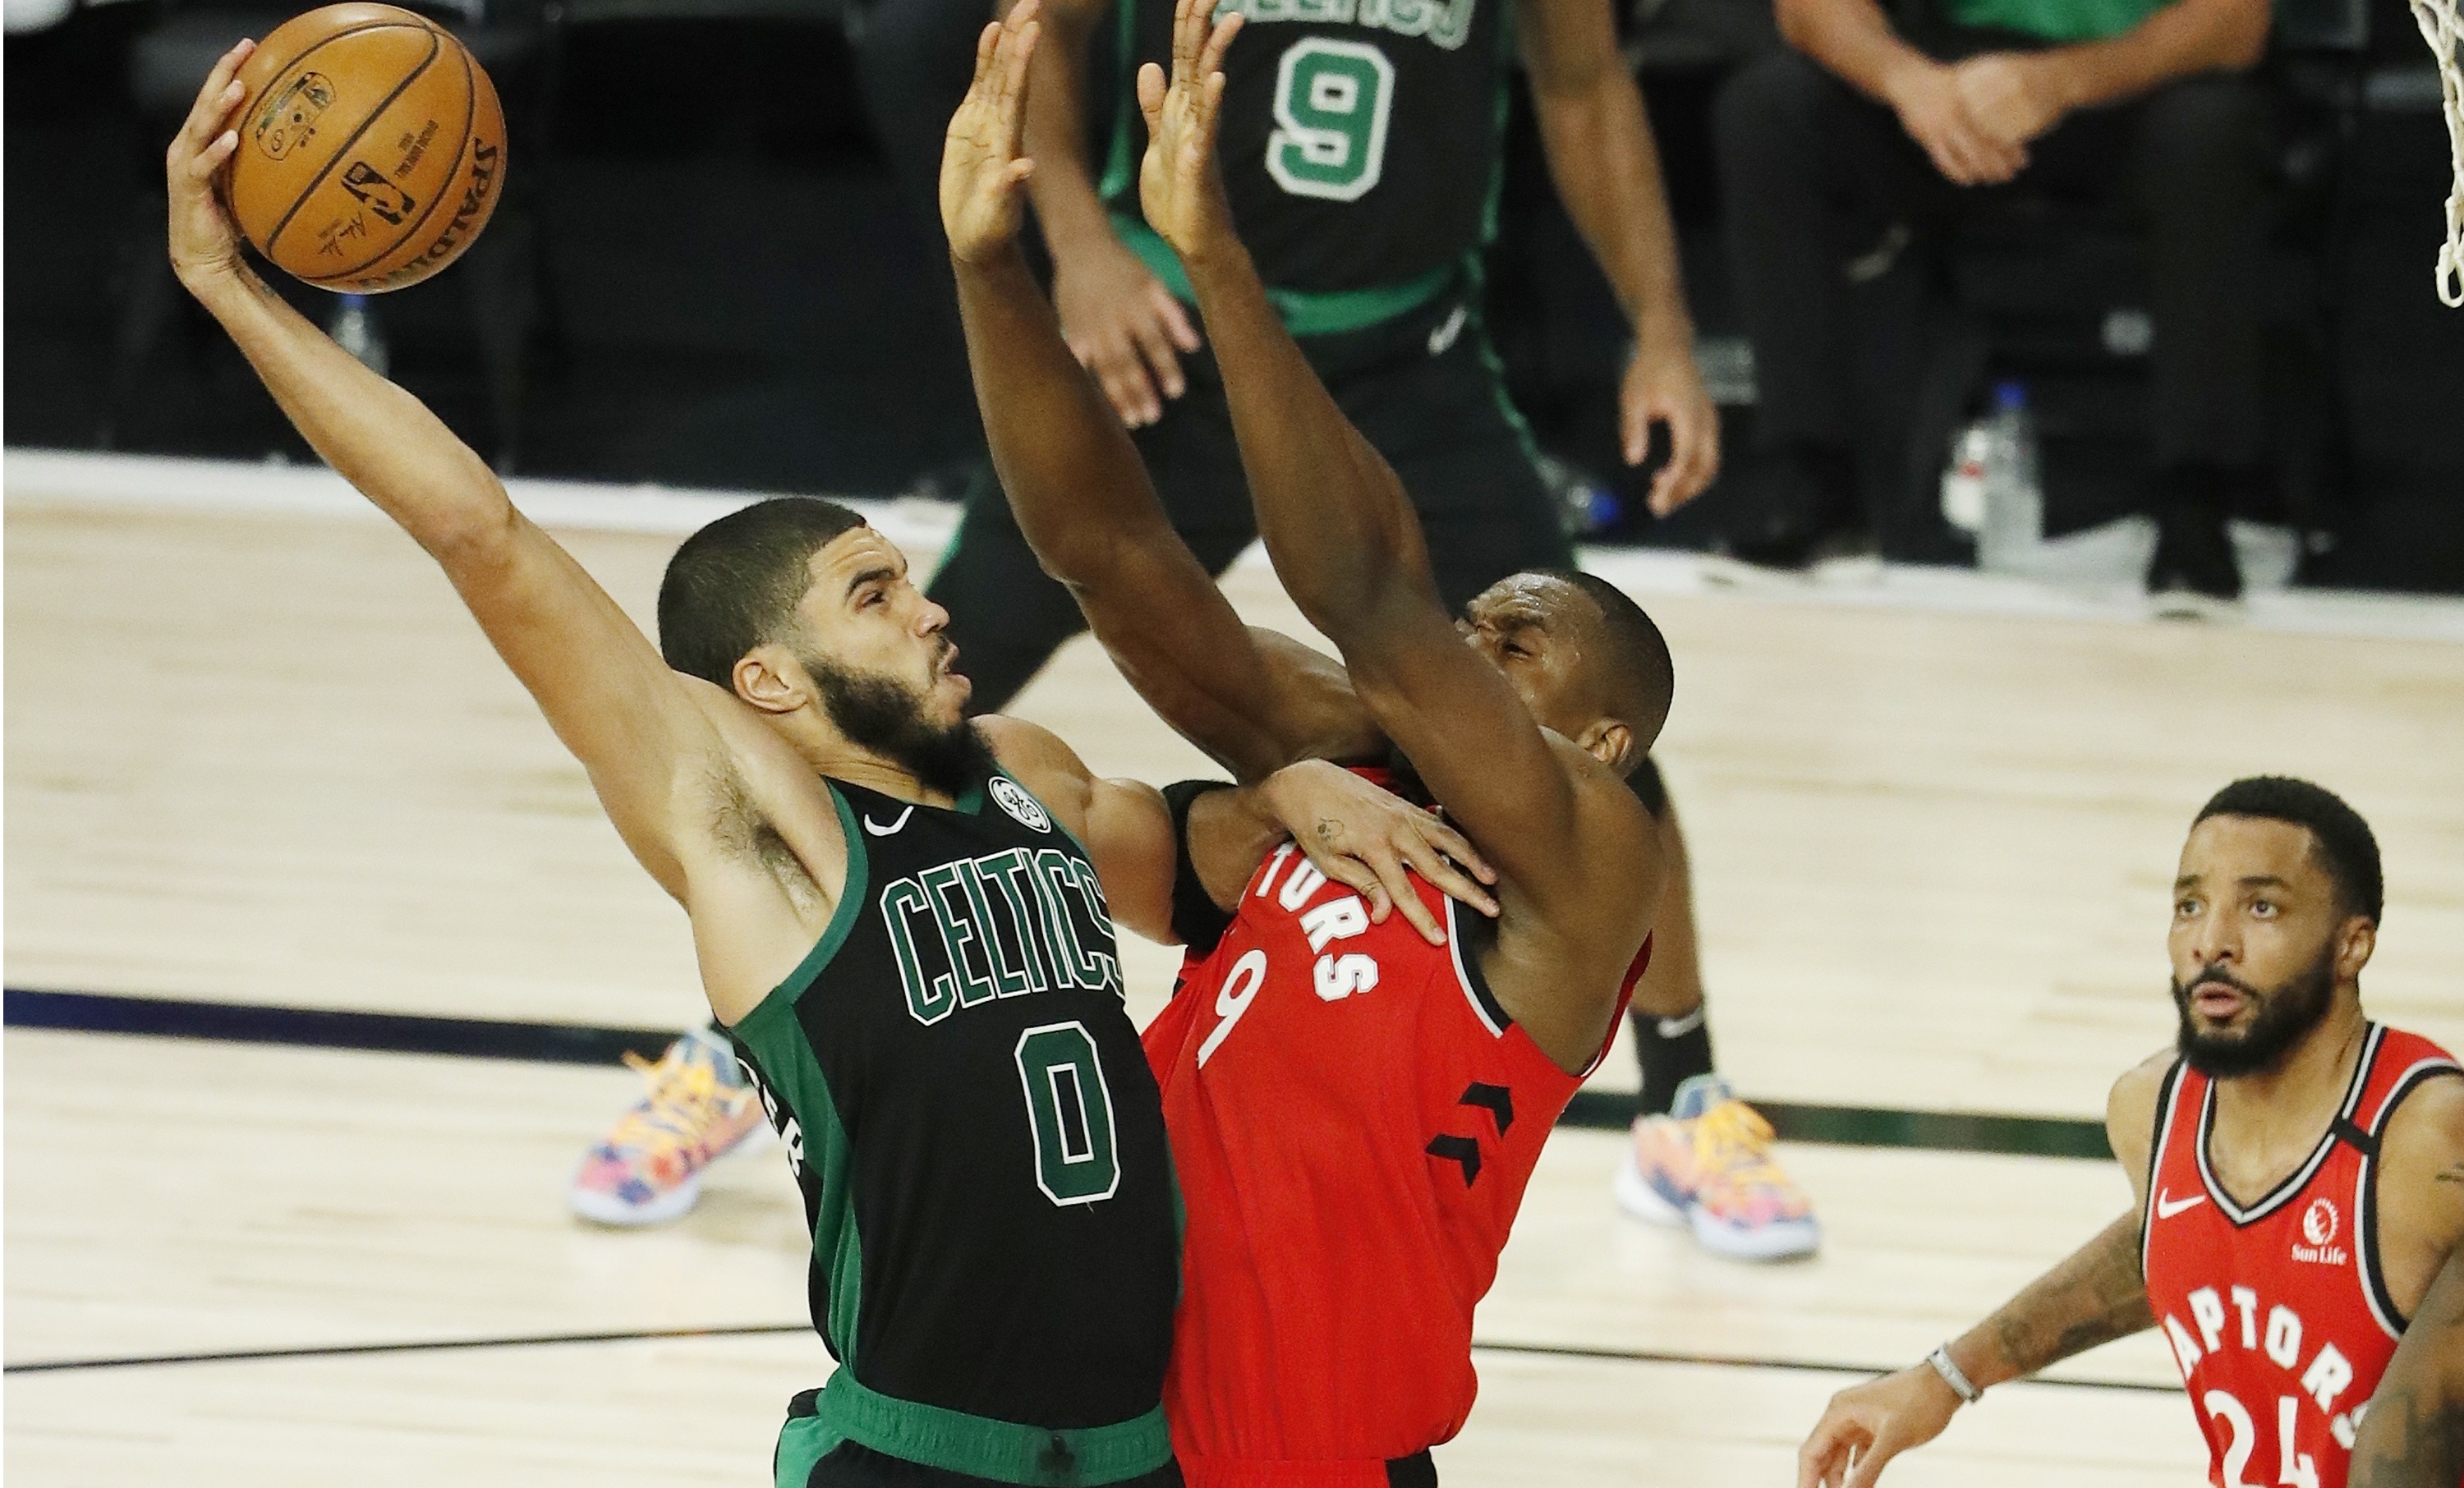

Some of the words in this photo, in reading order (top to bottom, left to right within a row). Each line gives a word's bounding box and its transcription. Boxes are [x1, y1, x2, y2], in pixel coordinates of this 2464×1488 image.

[1265, 36, 1395, 202] 9
[1255, 840, 1380, 1003] TORS
[1197, 948, 1267, 1070] 9
[1014, 1021, 1121, 1207] 0
[2292, 1243, 2318, 1263] Sun
[2319, 1245, 2347, 1265] Life
[2204, 1389, 2320, 1488] 24
